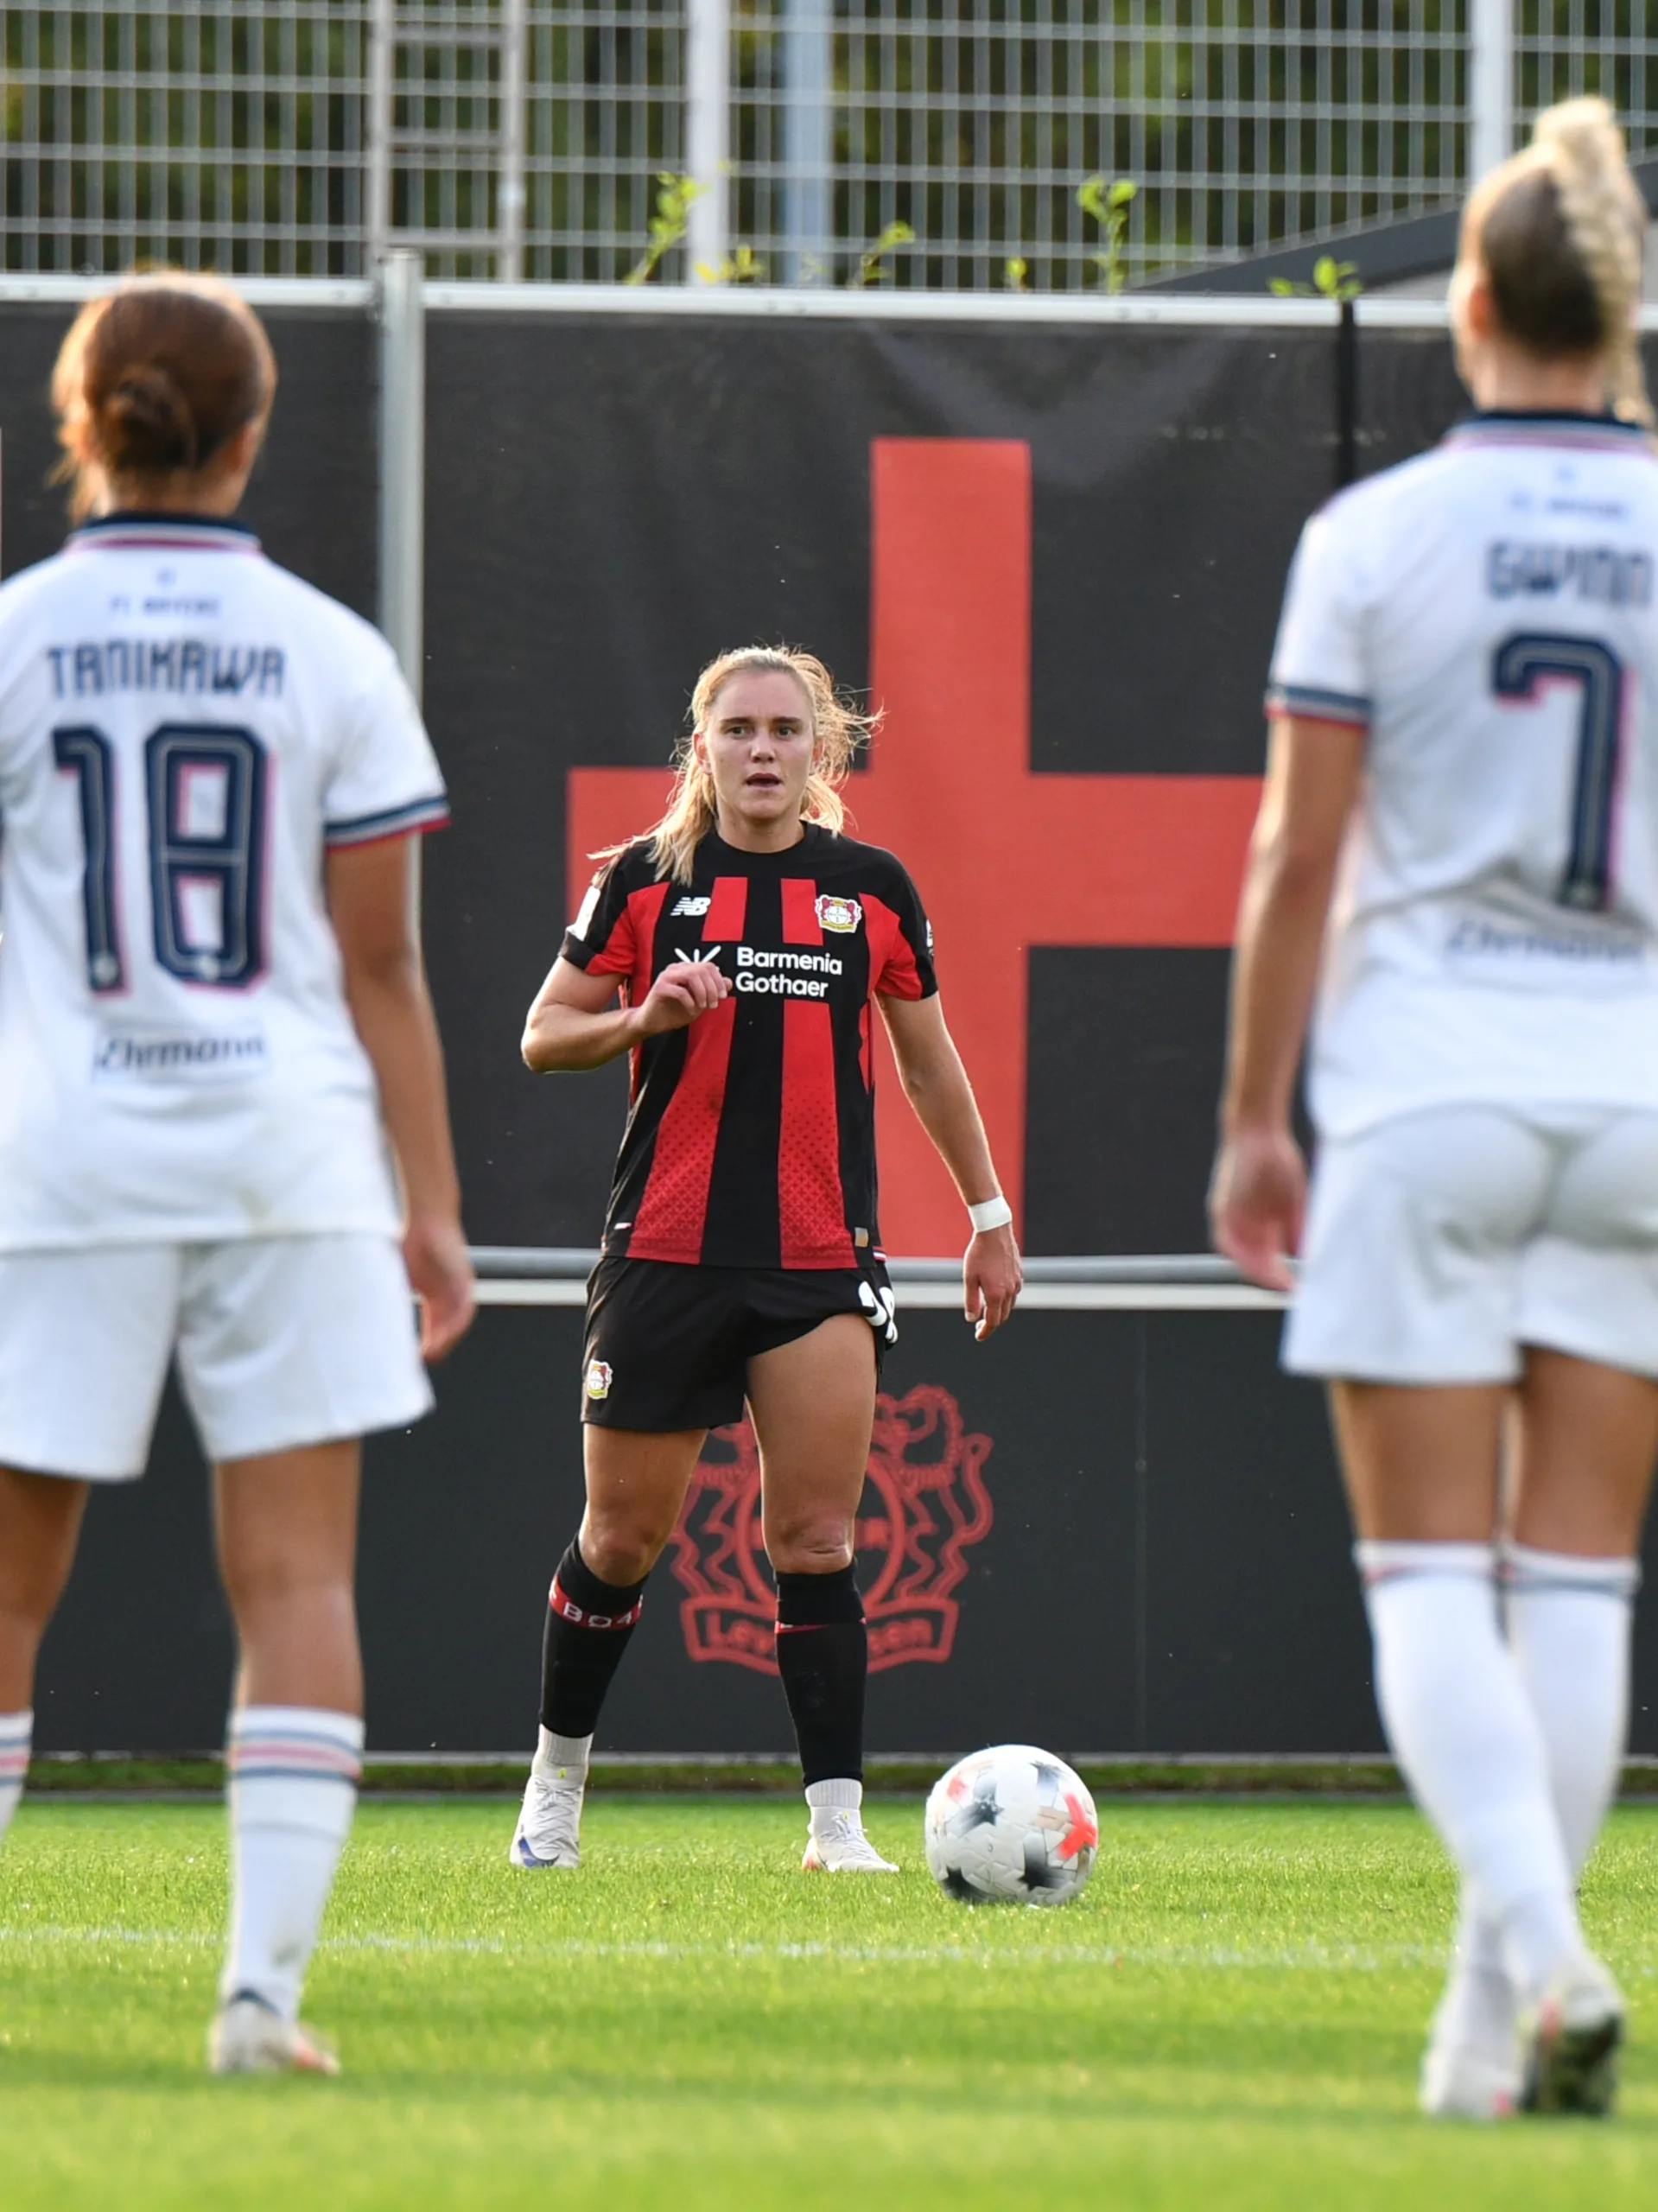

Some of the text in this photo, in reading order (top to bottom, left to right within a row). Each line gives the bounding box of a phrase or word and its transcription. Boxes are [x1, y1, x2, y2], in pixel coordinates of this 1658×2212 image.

[1488, 543, 1651, 607] GWINN
[48, 639, 286, 699] TANIKAWA
[1492, 632, 1631, 911] 7
[52, 722, 275, 995] 18
[734, 971, 829, 998] Gothaer
[736, 946, 843, 976] Barmenia
